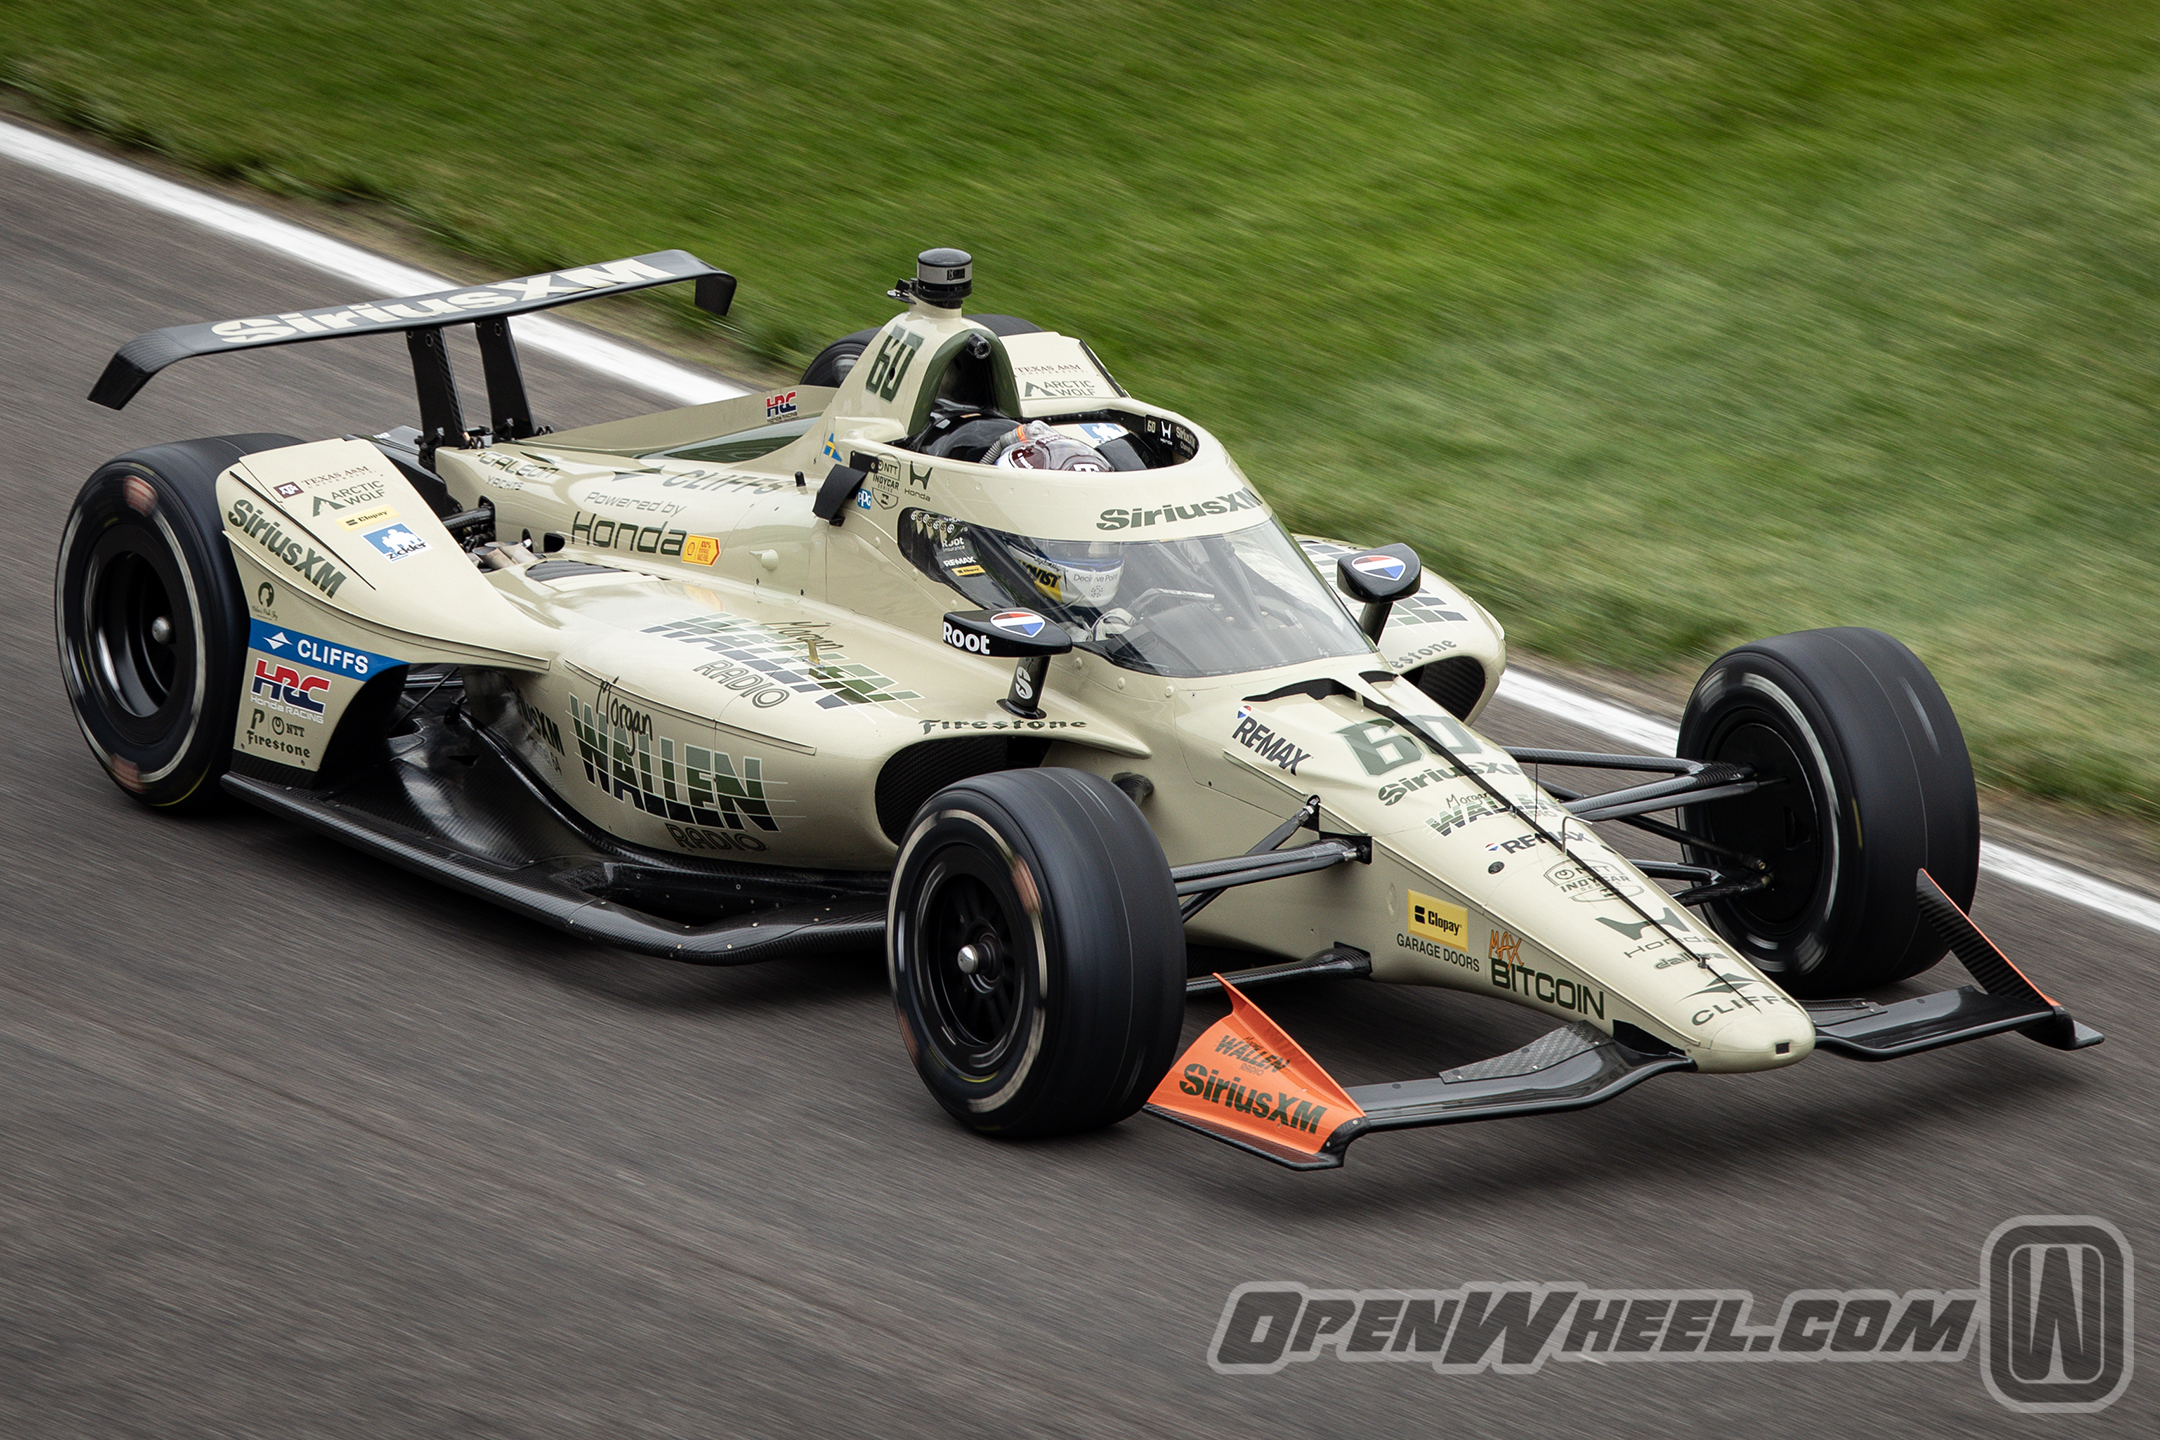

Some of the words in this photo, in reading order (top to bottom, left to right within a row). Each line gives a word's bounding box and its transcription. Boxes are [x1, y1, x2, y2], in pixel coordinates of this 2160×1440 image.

[210, 258, 674, 343] SiriusXM
[865, 323, 925, 403] 60
[1043, 380, 1095, 390] ARCTIC
[1055, 388, 1096, 397] WOLF
[1147, 420, 1156, 433] 60
[301, 471, 341, 486] TEXAS
[487, 475, 525, 491] YACHTS
[873, 473, 900, 490] INDYCAR
[884, 462, 898, 475] NTT
[331, 480, 384, 500] ARCTIC
[343, 489, 385, 506] WOLF
[584, 491, 660, 513] Powered
[661, 500, 687, 518] by
[904, 488, 931, 502] Honda
[228, 499, 348, 599] SiriusXM
[571, 511, 689, 557] Honda
[942, 621, 990, 655] Root
[297, 639, 369, 674] CLIFFS
[251, 657, 331, 716] HRC
[693, 659, 791, 709] RADIO
[250, 695, 284, 712] Honda
[286, 707, 324, 725] RACING
[596, 675, 654, 756] Morgan
[286, 723, 305, 738] NTT
[919, 718, 1087, 735] Firestone
[246, 730, 311, 758] Firestone
[1231, 715, 1312, 776] REMAX
[1334, 713, 1484, 777] 60
[567, 691, 782, 833] WALLEN
[664, 822, 767, 852] RADIO
[1427, 910, 1460, 936] Clopay
[1396, 932, 1441, 960] GARAGE
[1443, 946, 1480, 973] DOORS
[1488, 929, 1525, 970] MAX
[1490, 957, 1605, 1021] BITCOIN
[1214, 1034, 1290, 1073] WALLEN
[1239, 1062, 1265, 1077] RADIO
[1178, 1062, 1328, 1135] SiriusXM
